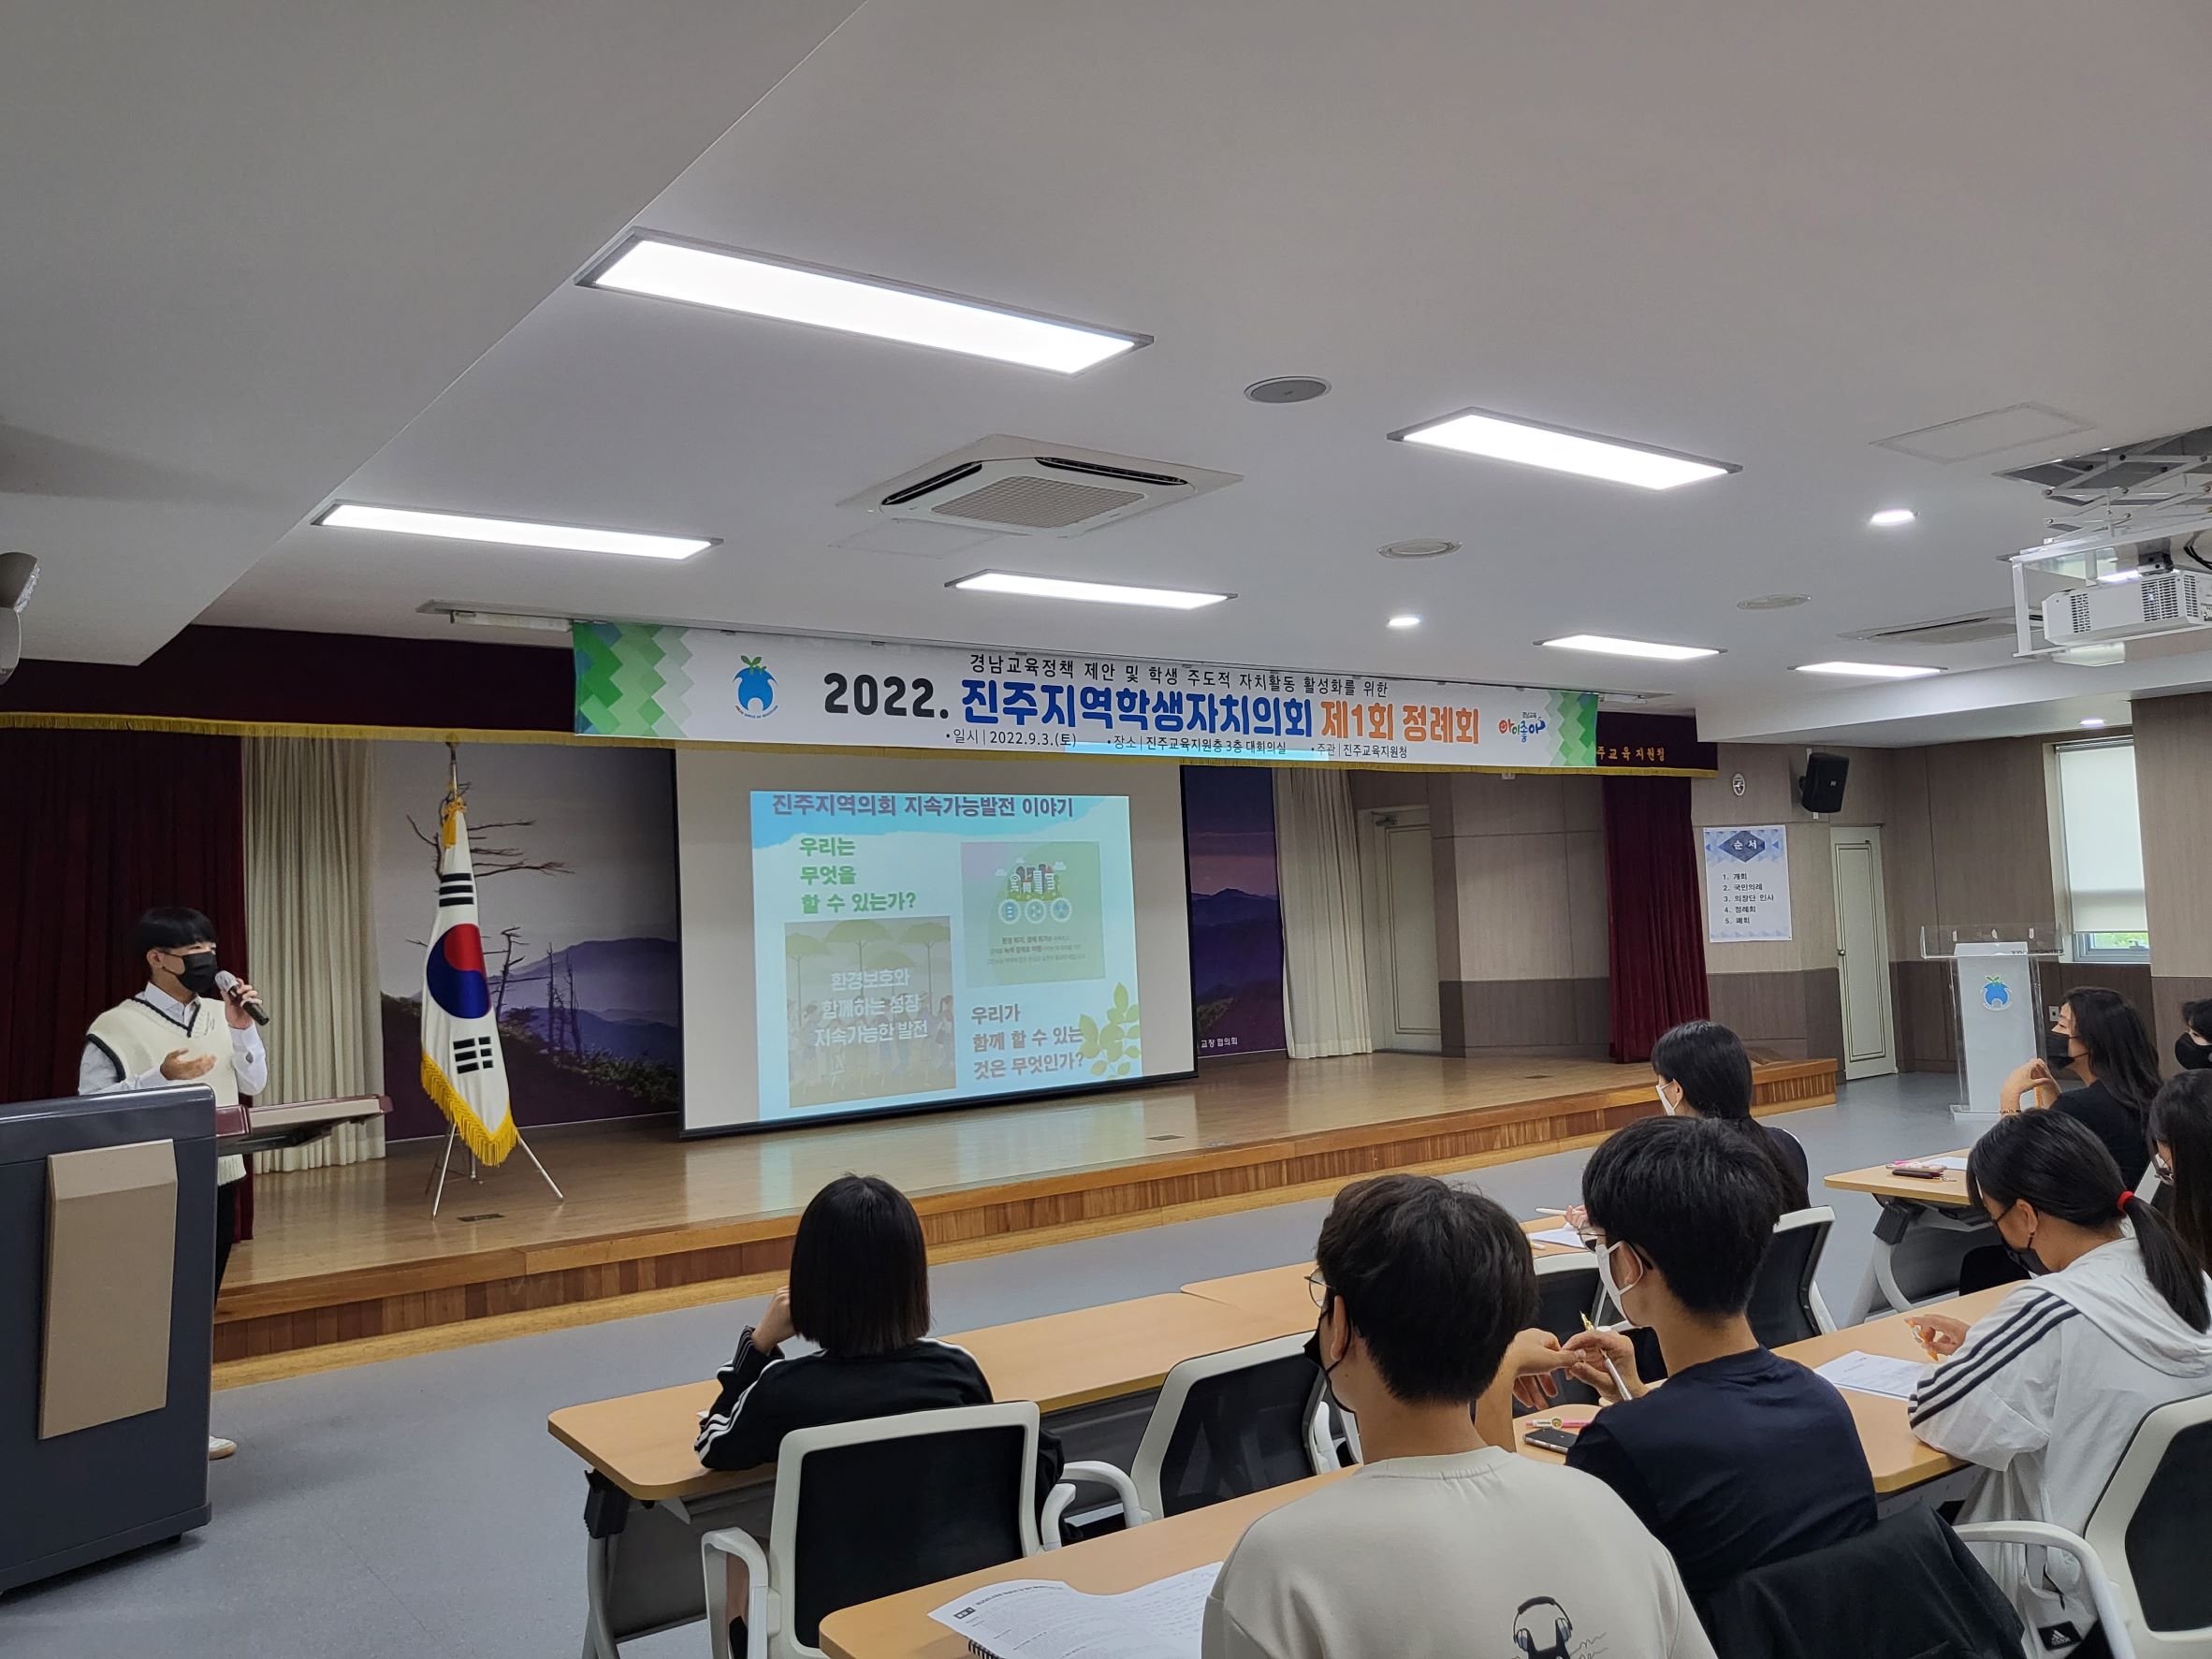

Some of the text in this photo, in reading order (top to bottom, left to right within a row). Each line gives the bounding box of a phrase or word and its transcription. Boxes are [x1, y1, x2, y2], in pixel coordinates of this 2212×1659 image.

[970, 654, 1389, 698] 경남교육정책 제안 및 학생 주도적 자치활동 활성화를 위한
[823, 672, 1479, 744] 2022. 진주지역학생자치의회 제1회 정례회
[1226, 739, 1244, 753] 3층
[1246, 740, 1287, 755] 대회의실
[772, 793, 1073, 818] 진주지역의회 지속가능발전 이야기
[799, 837, 855, 856] 우리는
[800, 866, 856, 885] 무엇을
[801, 892, 916, 914] 할 수 있는가?
[1759, 894, 1774, 902] 인사
[830, 968, 910, 991] 환경보호와
[822, 994, 921, 1019] 함께하는 성장
[971, 1003, 1020, 1025] 우리가
[813, 1019, 928, 1047] 지속가능한 발전
[973, 1026, 1084, 1053] 함께 할 수 있는
[974, 1052, 1084, 1080] 것은 무엇인가?
